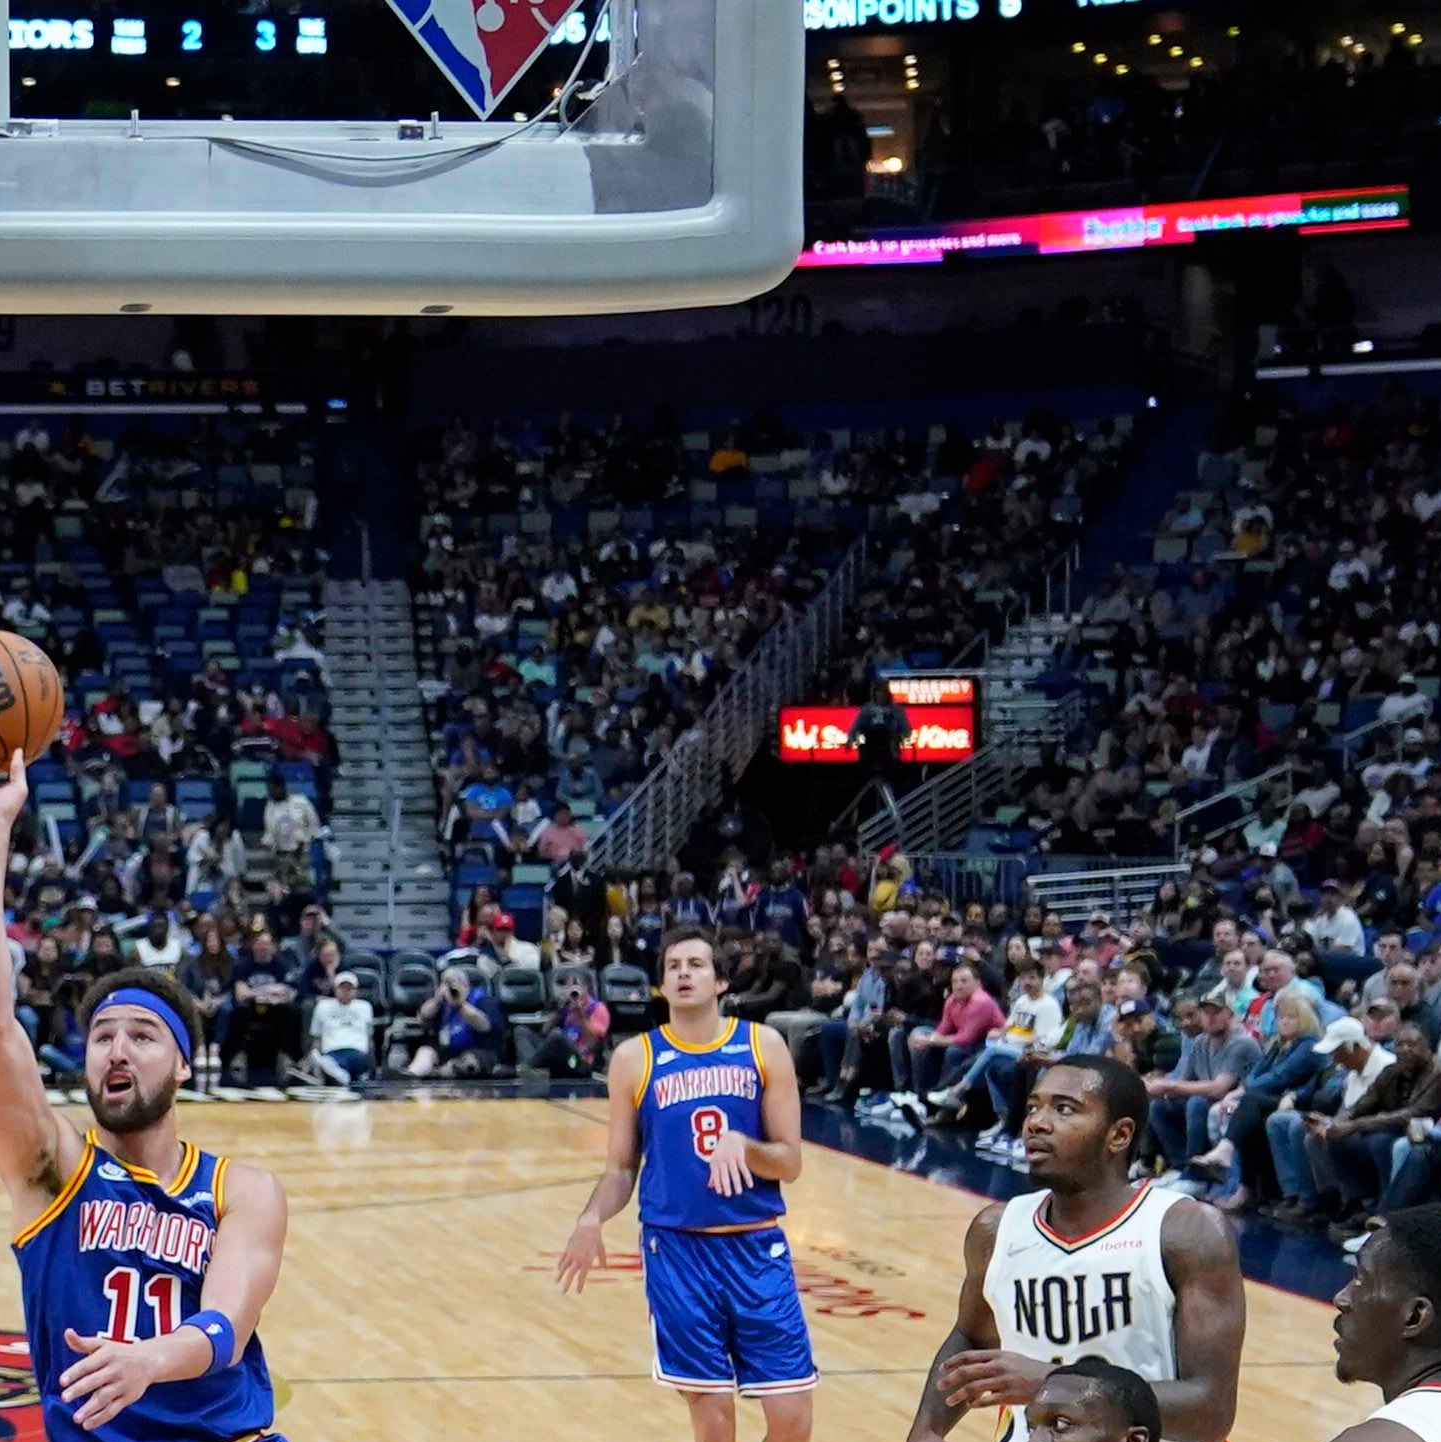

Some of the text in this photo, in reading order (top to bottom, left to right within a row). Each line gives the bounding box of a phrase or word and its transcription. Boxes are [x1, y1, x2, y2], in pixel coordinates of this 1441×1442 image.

[85, 377, 262, 397] BETRIVERS
[888, 679, 970, 695] MERGENCY
[653, 1065, 757, 1110] WARRIORS
[690, 1105, 730, 1163] 8
[1100, 1239, 1144, 1252] ibotta
[96, 1265, 182, 1345] 11
[1014, 1271, 1133, 1346] NOLA
